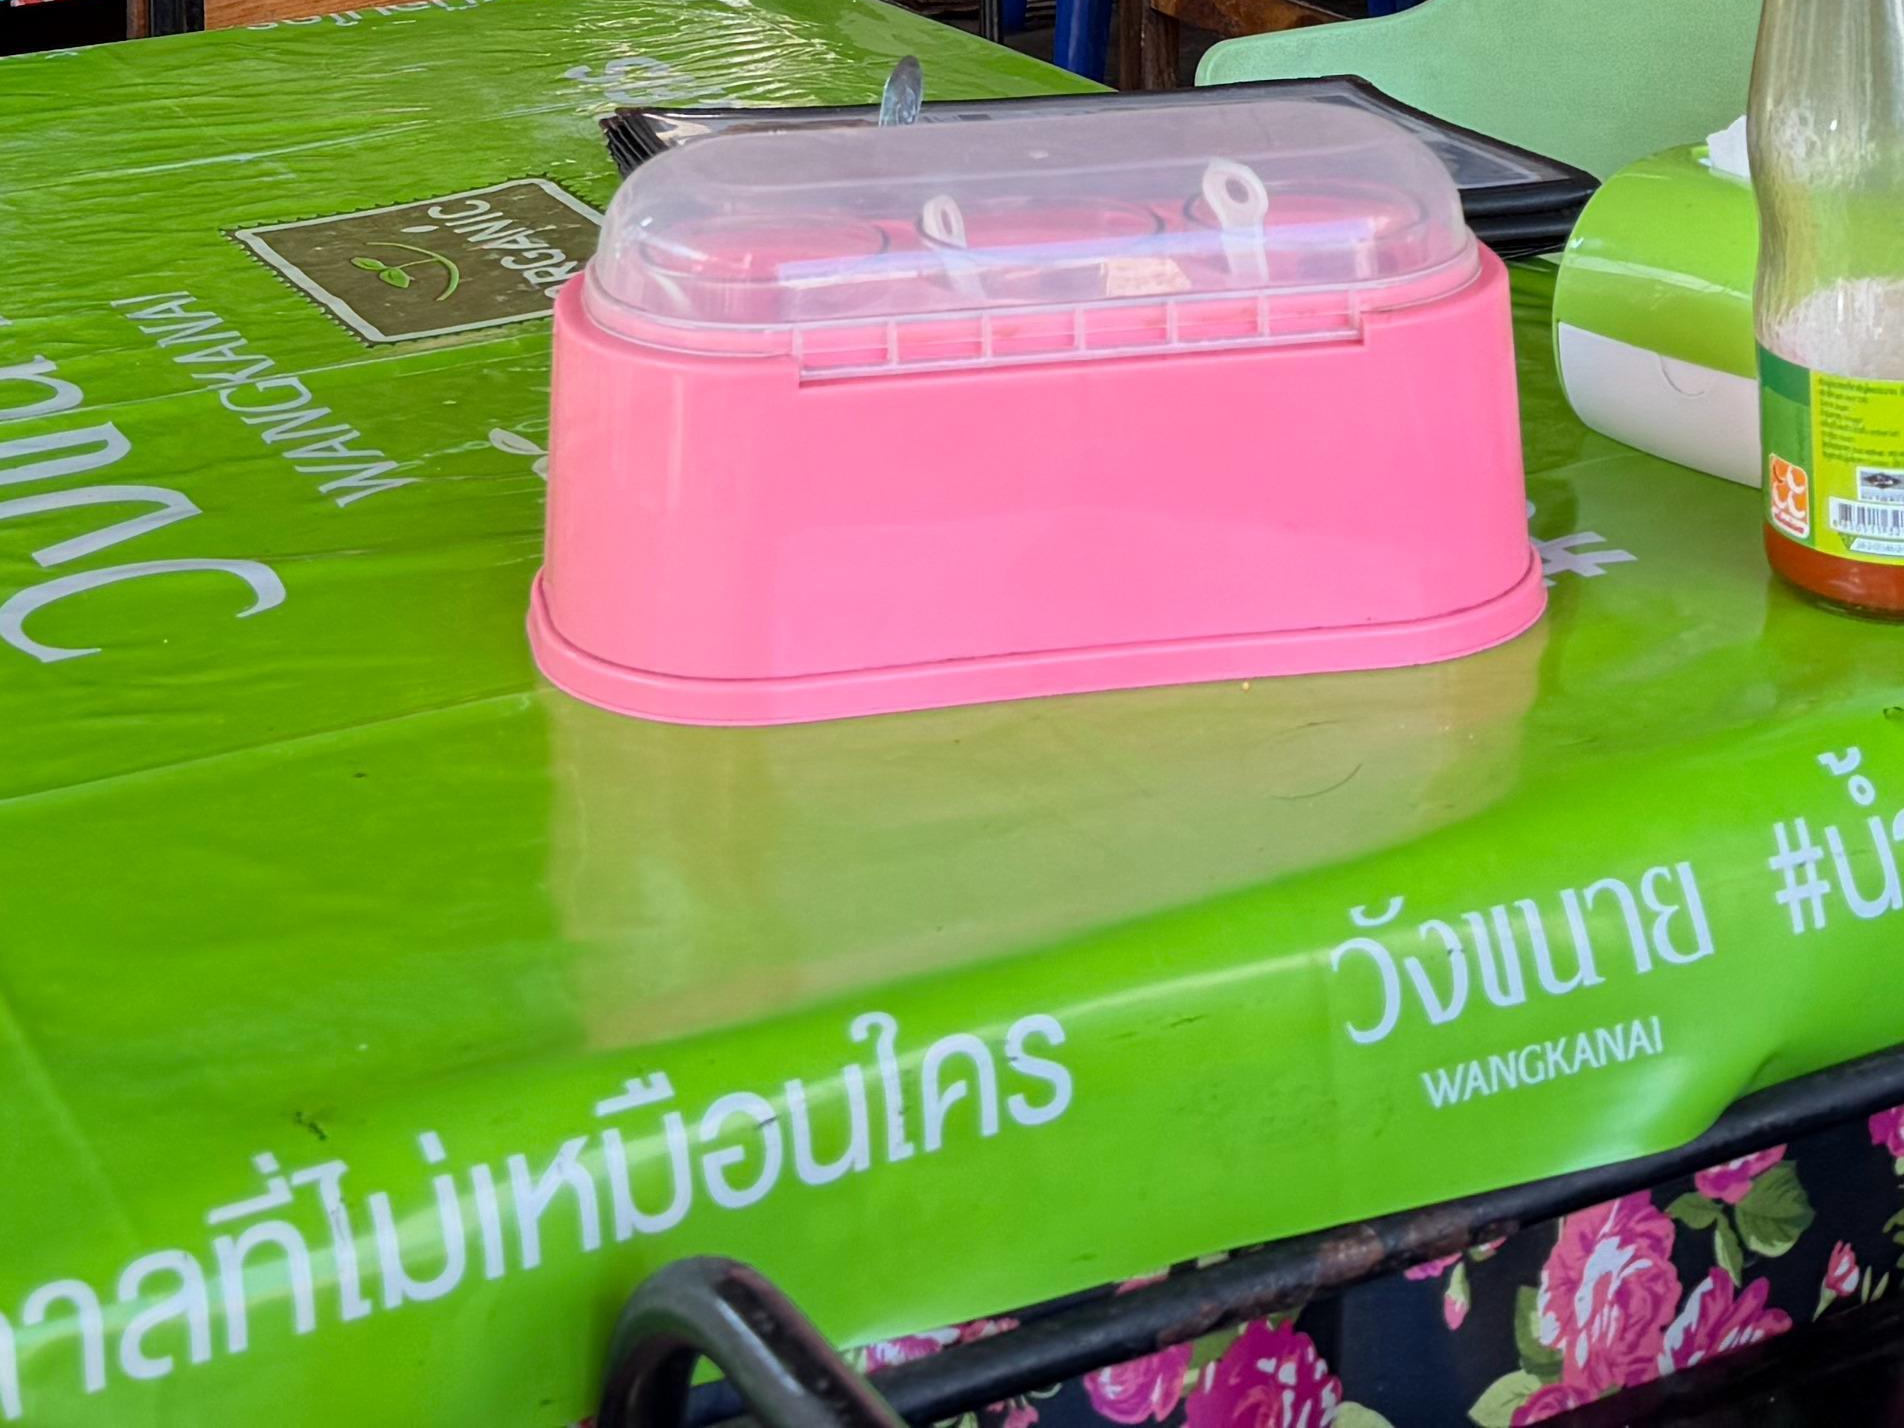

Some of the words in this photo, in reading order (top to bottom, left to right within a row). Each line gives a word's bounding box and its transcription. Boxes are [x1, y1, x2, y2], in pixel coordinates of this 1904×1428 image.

[427, 199, 586, 300] RGANIC
[108, 289, 420, 509] WANGKANAI
[1328, 862, 1715, 1051] วังขนาย
[1419, 1015, 1664, 1111] WANGKANAI
